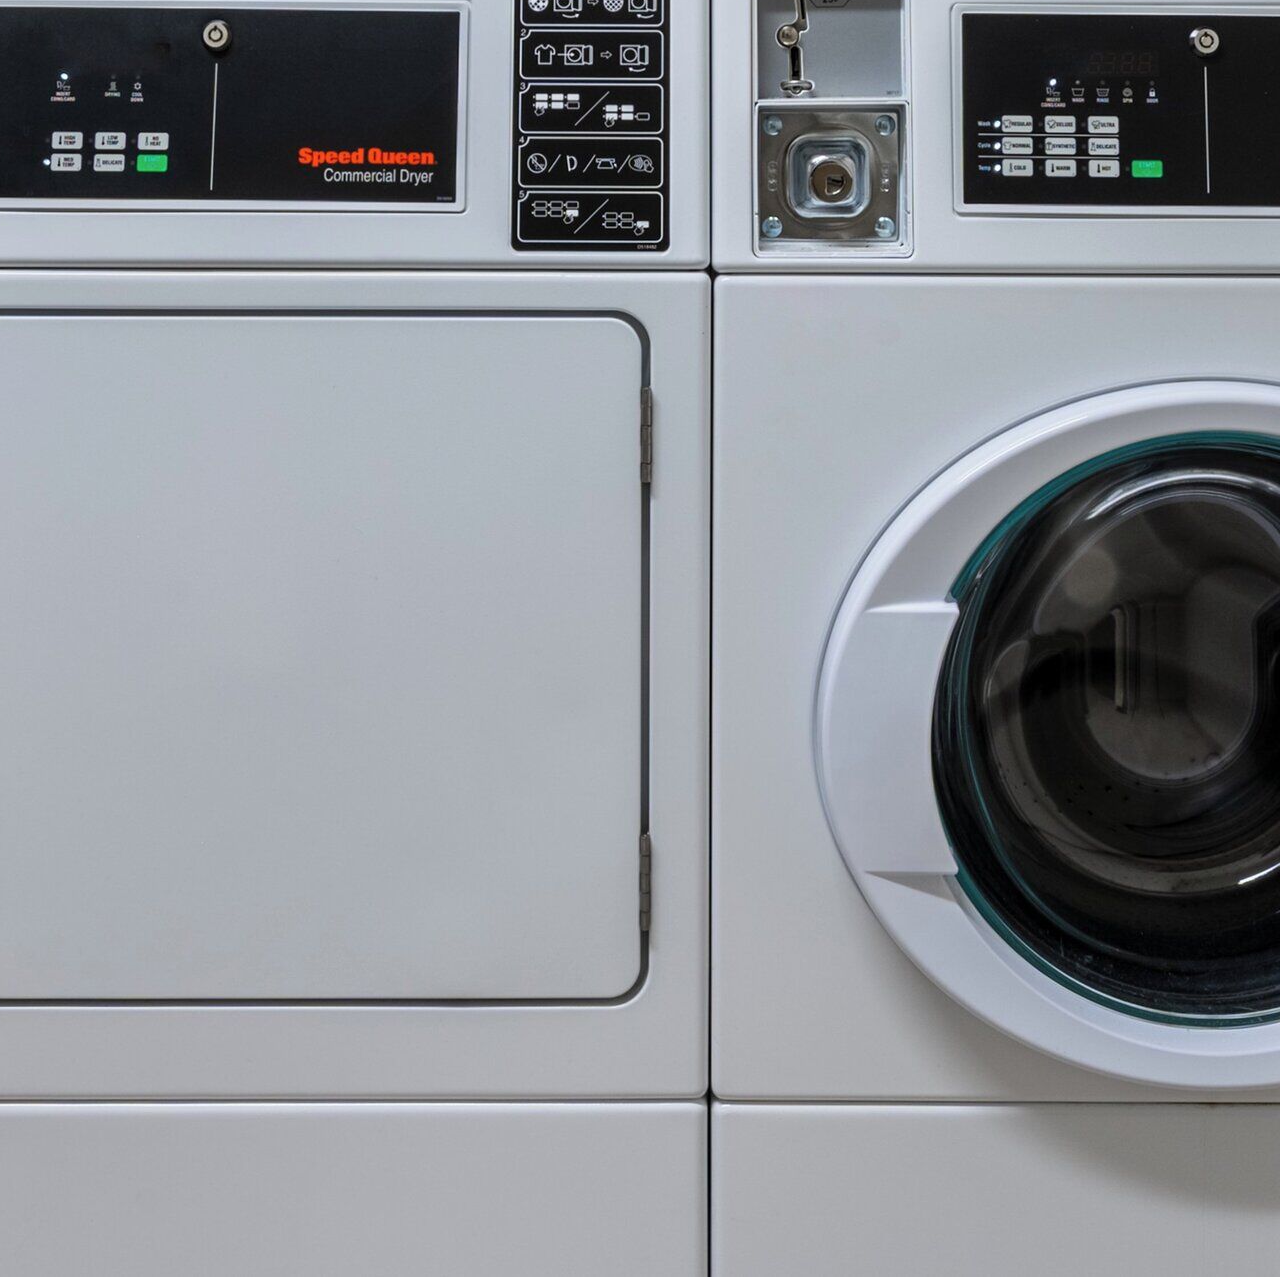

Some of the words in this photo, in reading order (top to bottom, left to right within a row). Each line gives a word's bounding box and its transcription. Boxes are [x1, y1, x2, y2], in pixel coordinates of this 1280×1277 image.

[520, 82, 526, 90] 3
[298, 147, 364, 167] Speed
[367, 148, 435, 165] Queen
[323, 168, 396, 183] Commercial
[400, 169, 434, 186] Dryer
